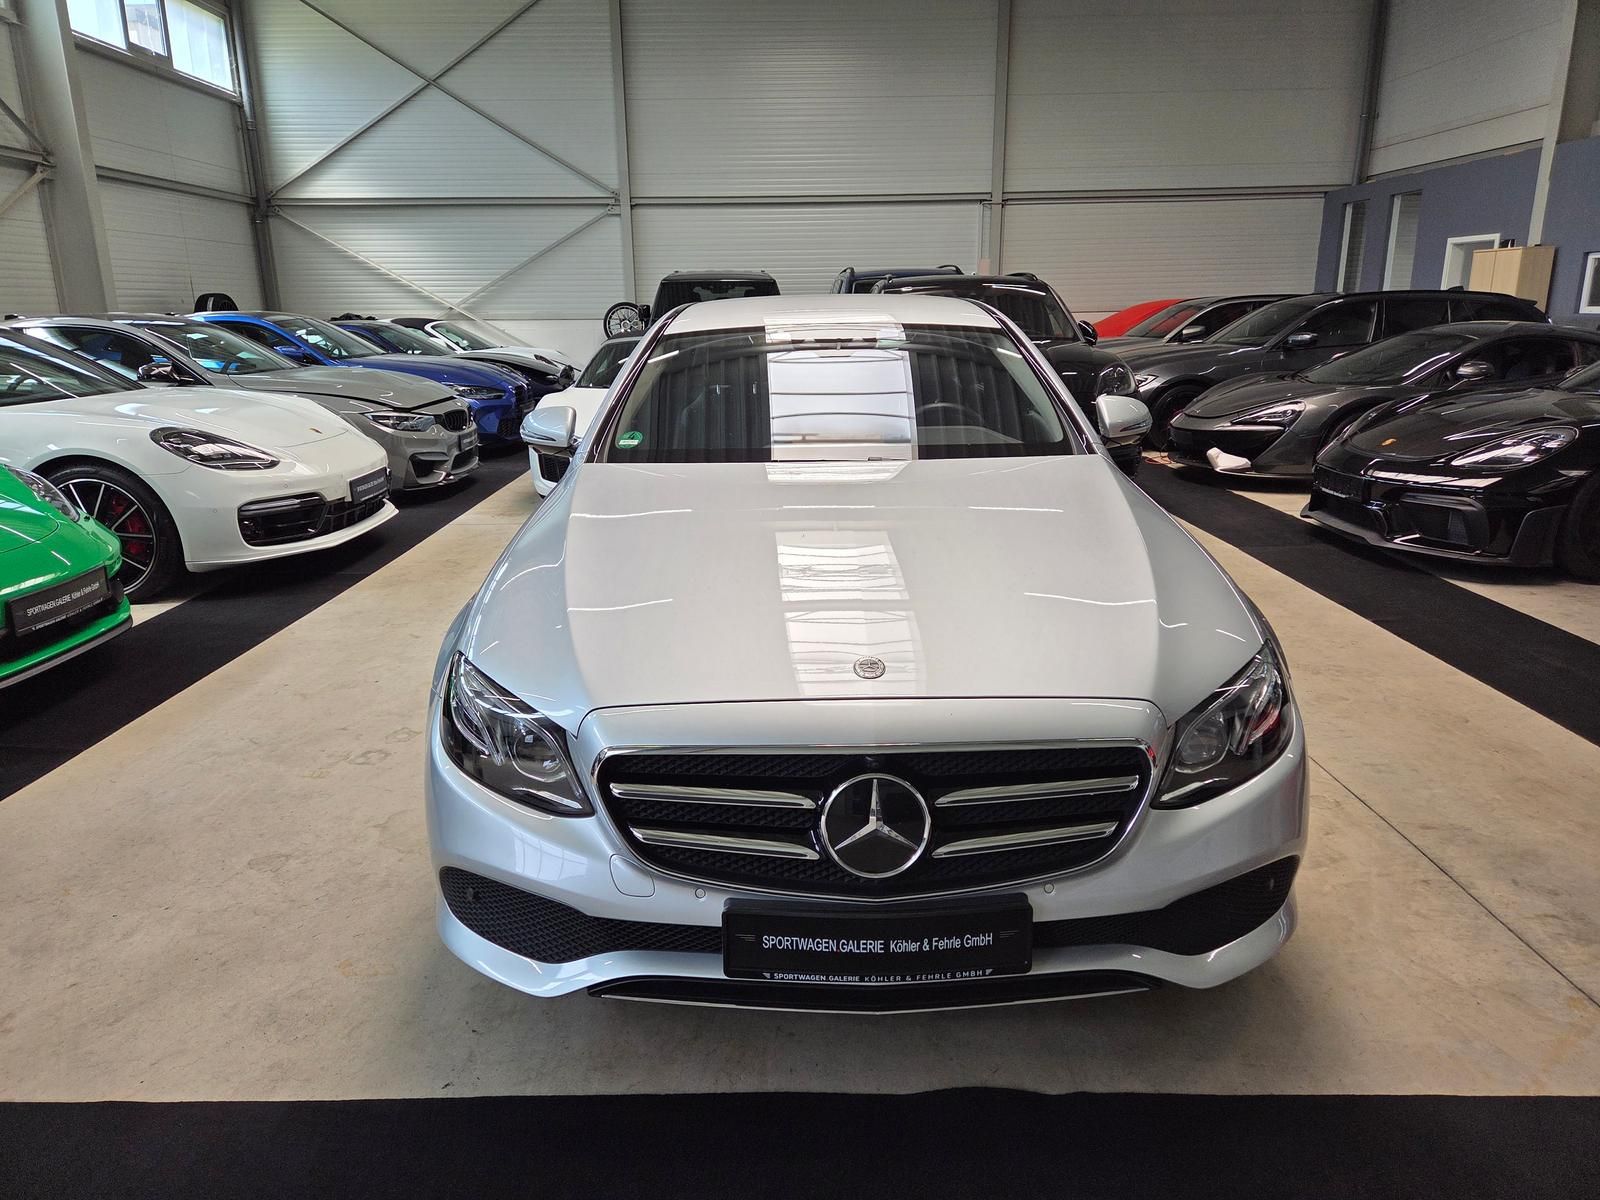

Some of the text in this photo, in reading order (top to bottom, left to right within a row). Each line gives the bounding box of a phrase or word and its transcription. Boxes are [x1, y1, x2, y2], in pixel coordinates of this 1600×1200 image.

[890, 939, 920, 953] Köhler
[922, 938, 930, 951] &
[932, 936, 961, 950] Fehrle
[963, 932, 993, 948] GmbH
[864, 974, 901, 982] KÖHLER
[916, 972, 951, 981] FEHRLE
[956, 969, 983, 978] GMBH
